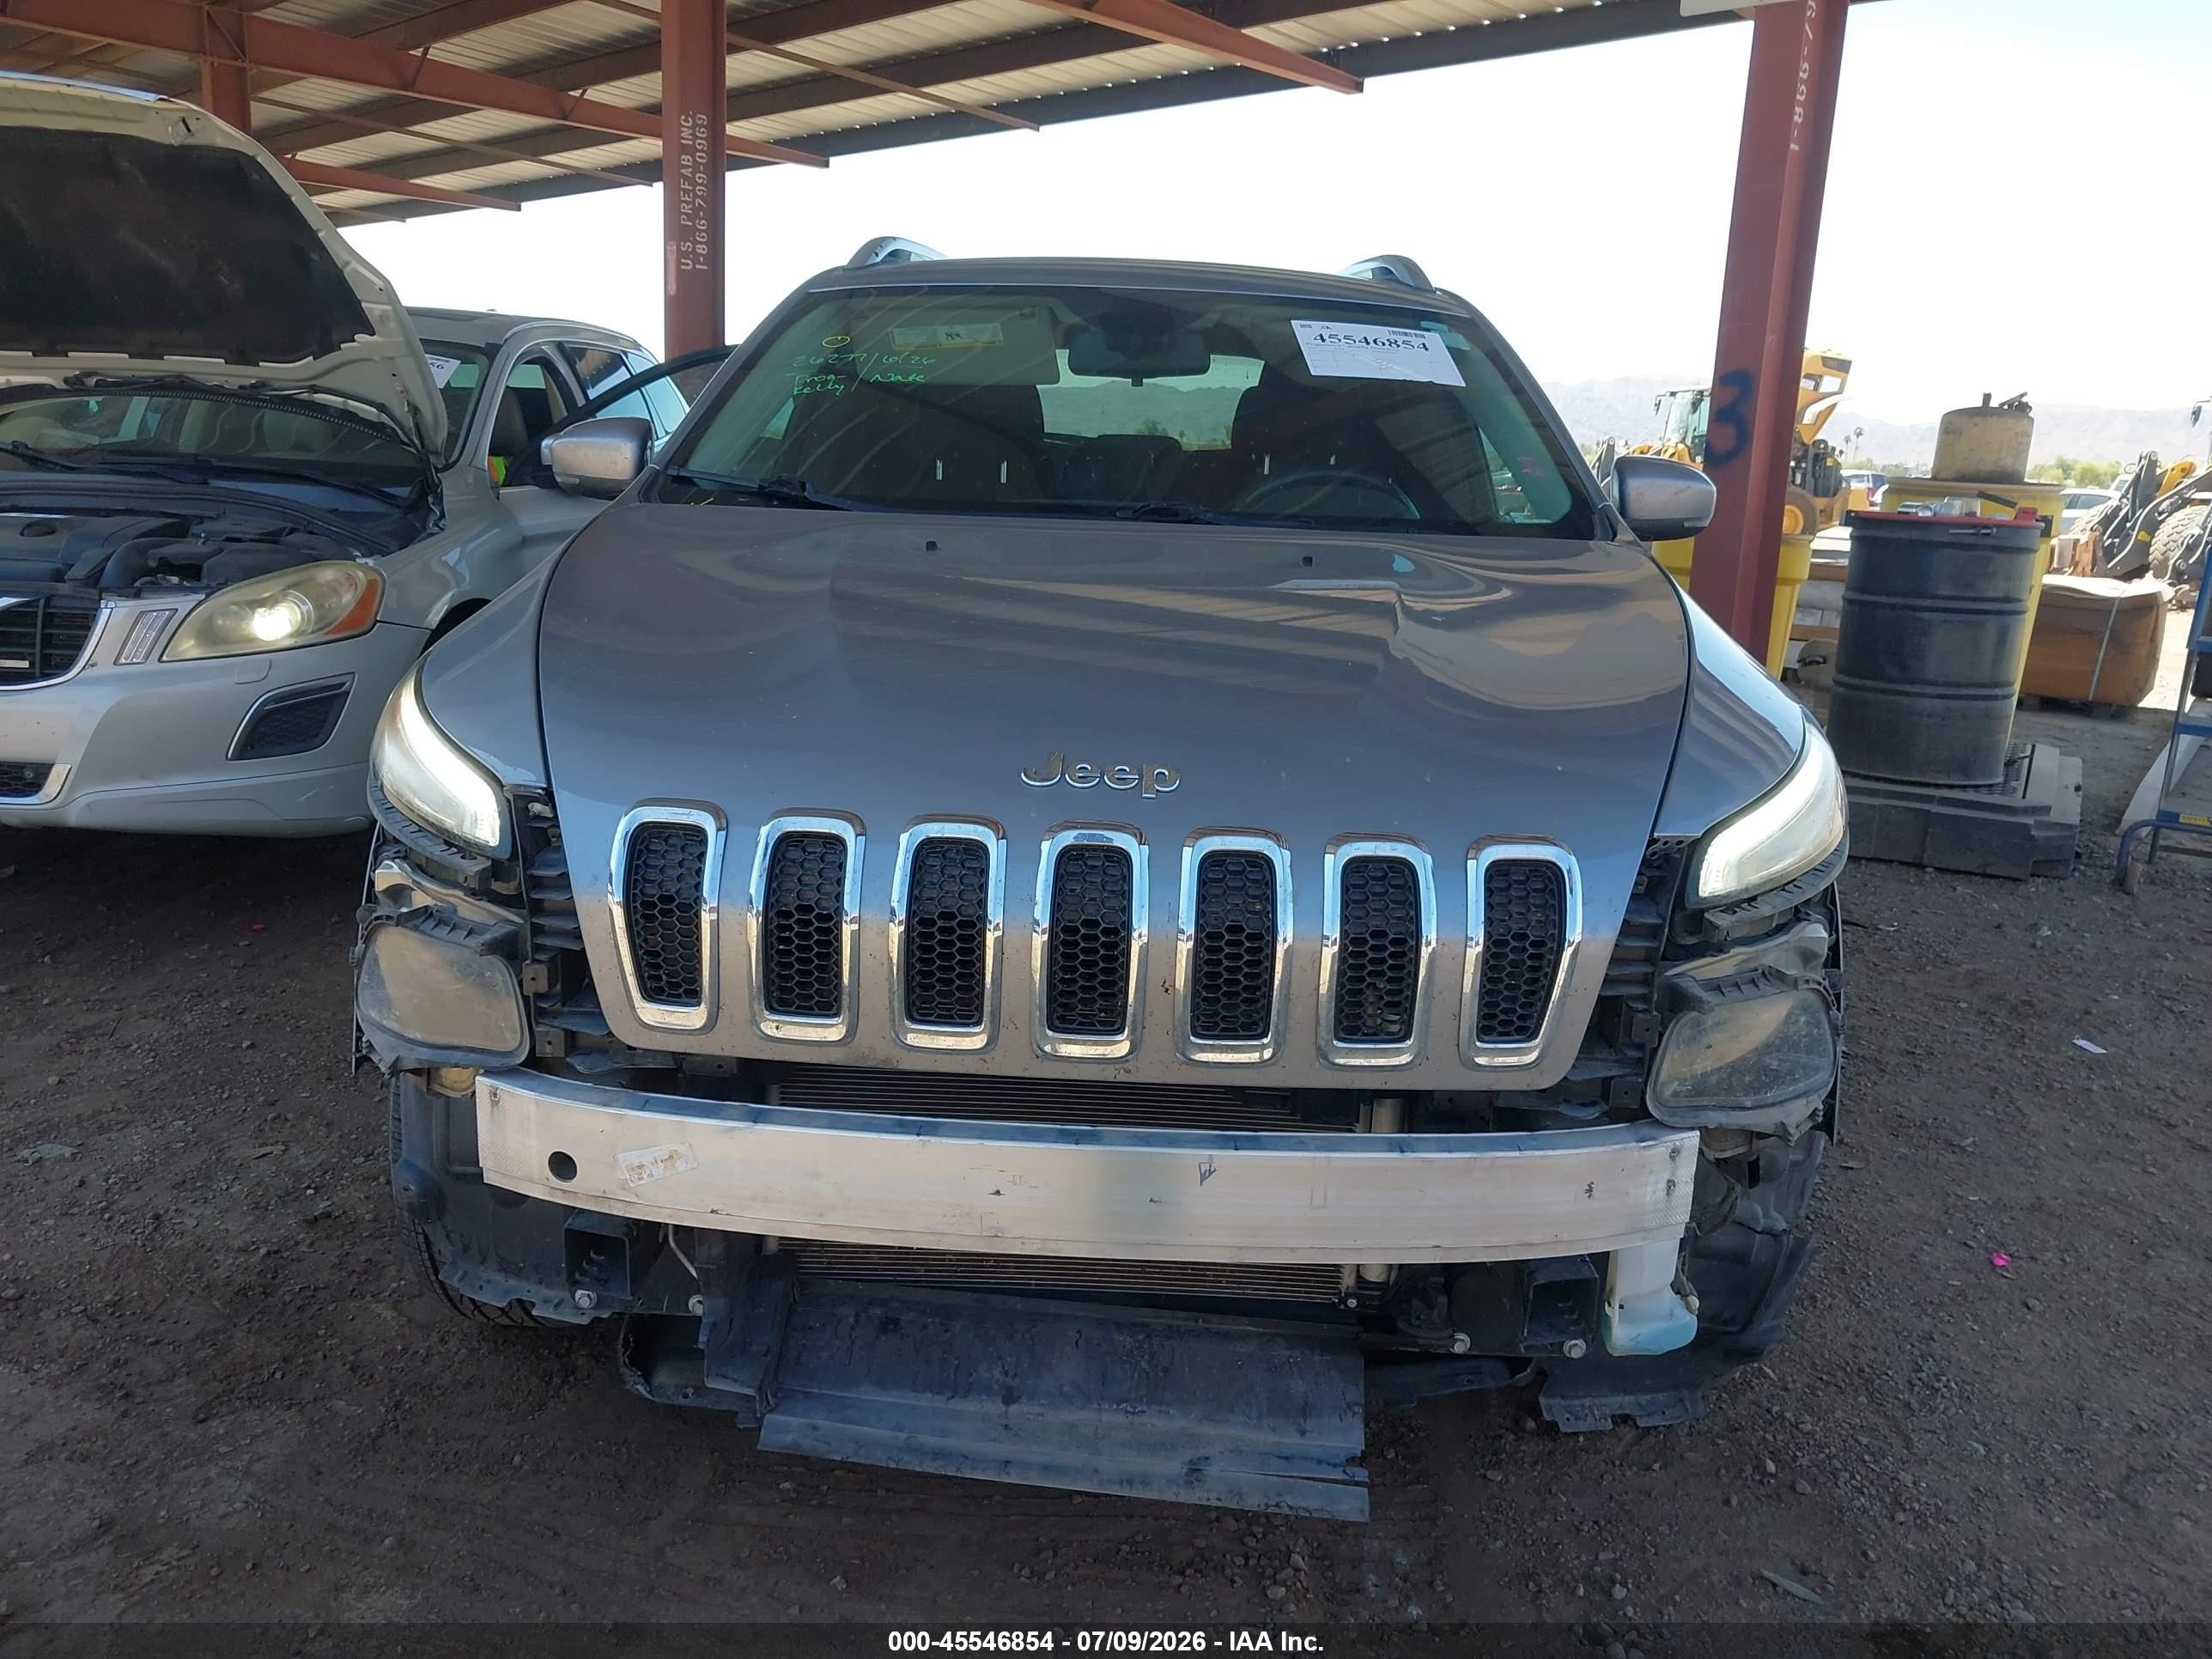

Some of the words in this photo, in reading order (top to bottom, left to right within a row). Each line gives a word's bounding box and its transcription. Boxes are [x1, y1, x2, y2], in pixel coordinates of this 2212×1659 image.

[680, 110, 694, 145] INC.
[680, 155, 694, 226] PREFAB
[696, 113, 708, 270] 1-866-799-0969
[680, 237, 694, 271] U.S.
[1313, 332, 1430, 352] 45546854
[1704, 368, 1754, 468] 3
[1020, 750, 1182, 799] Jeep
